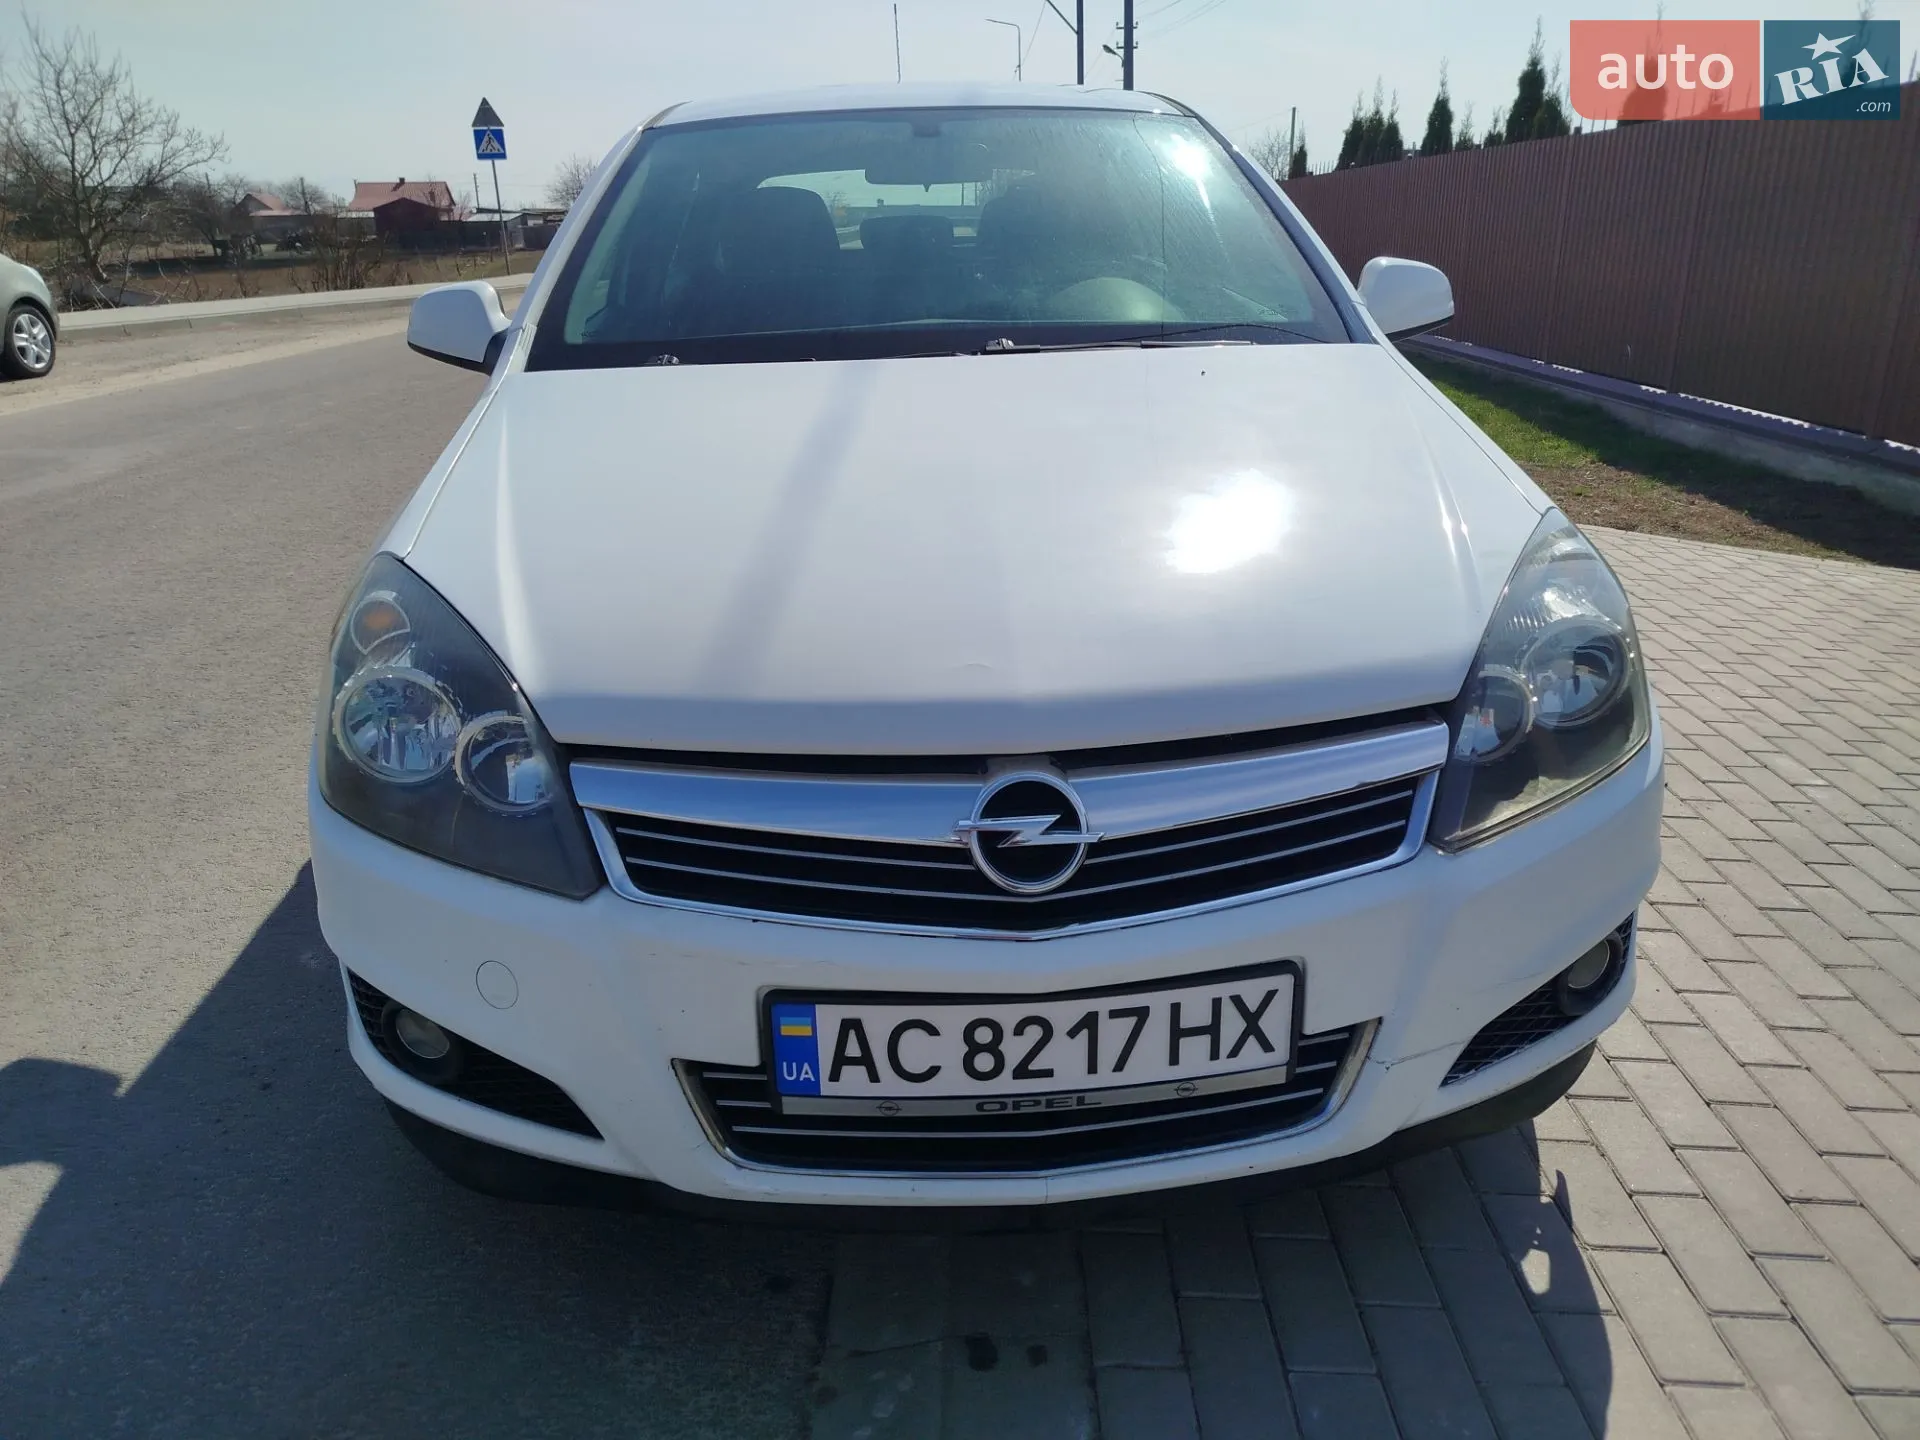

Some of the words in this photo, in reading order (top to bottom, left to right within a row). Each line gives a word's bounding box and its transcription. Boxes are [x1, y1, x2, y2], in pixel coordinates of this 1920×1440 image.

[827, 1018, 942, 1084] AC
[962, 1005, 1150, 1082] 8217
[1168, 988, 1279, 1067] HX
[782, 1061, 816, 1082] UA
[975, 1095, 1103, 1114] OPEL
